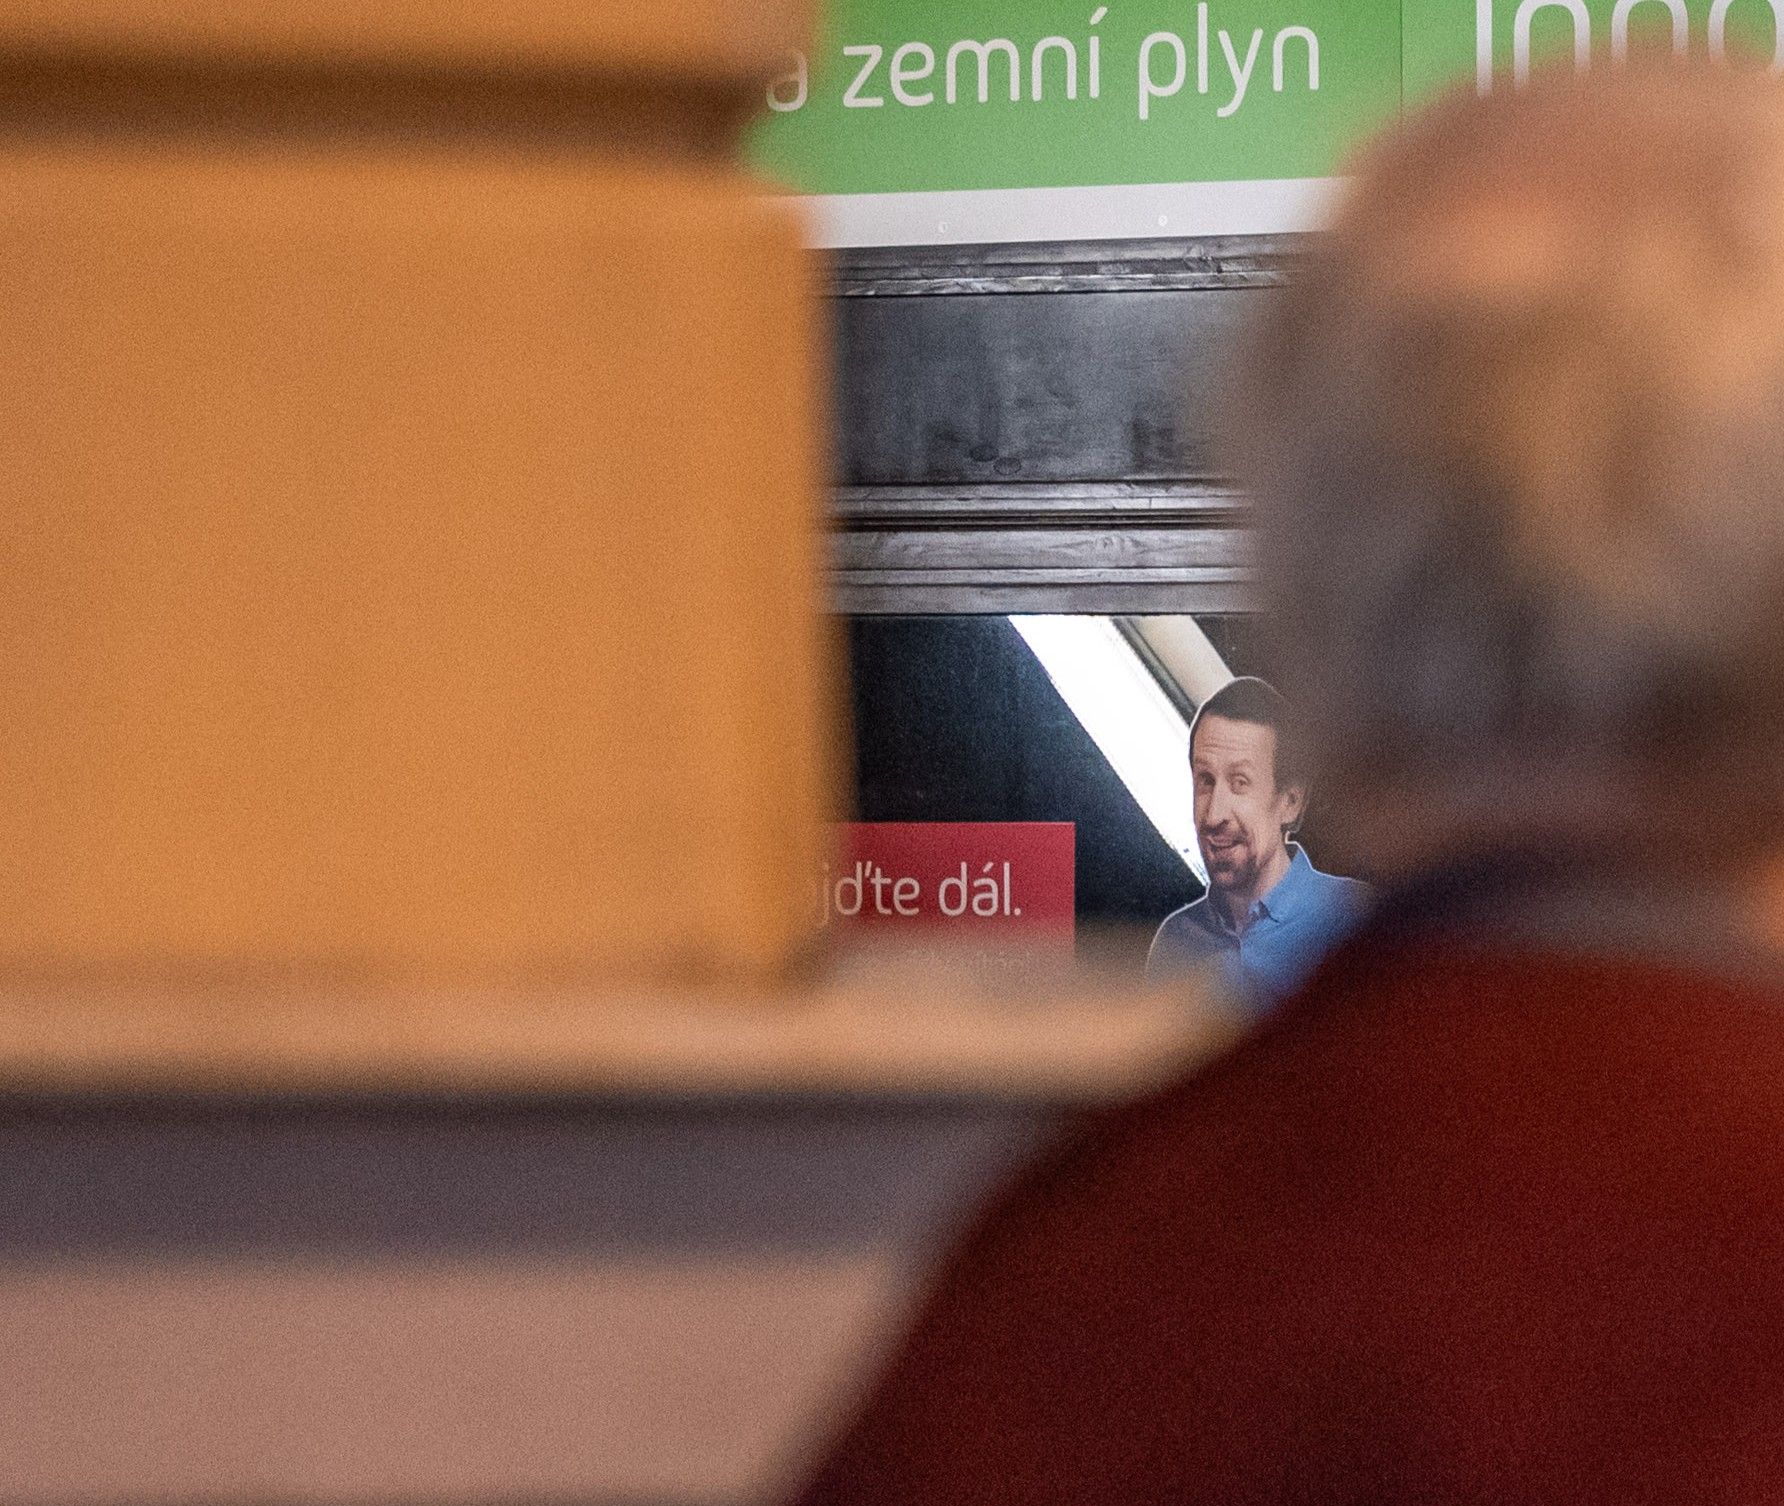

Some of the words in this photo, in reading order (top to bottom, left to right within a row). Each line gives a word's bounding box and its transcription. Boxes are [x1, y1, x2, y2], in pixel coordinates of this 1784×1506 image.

[843, 5, 1108, 109] zemní
[1138, 2, 1321, 120] plyn
[937, 861, 1022, 917] dál.
